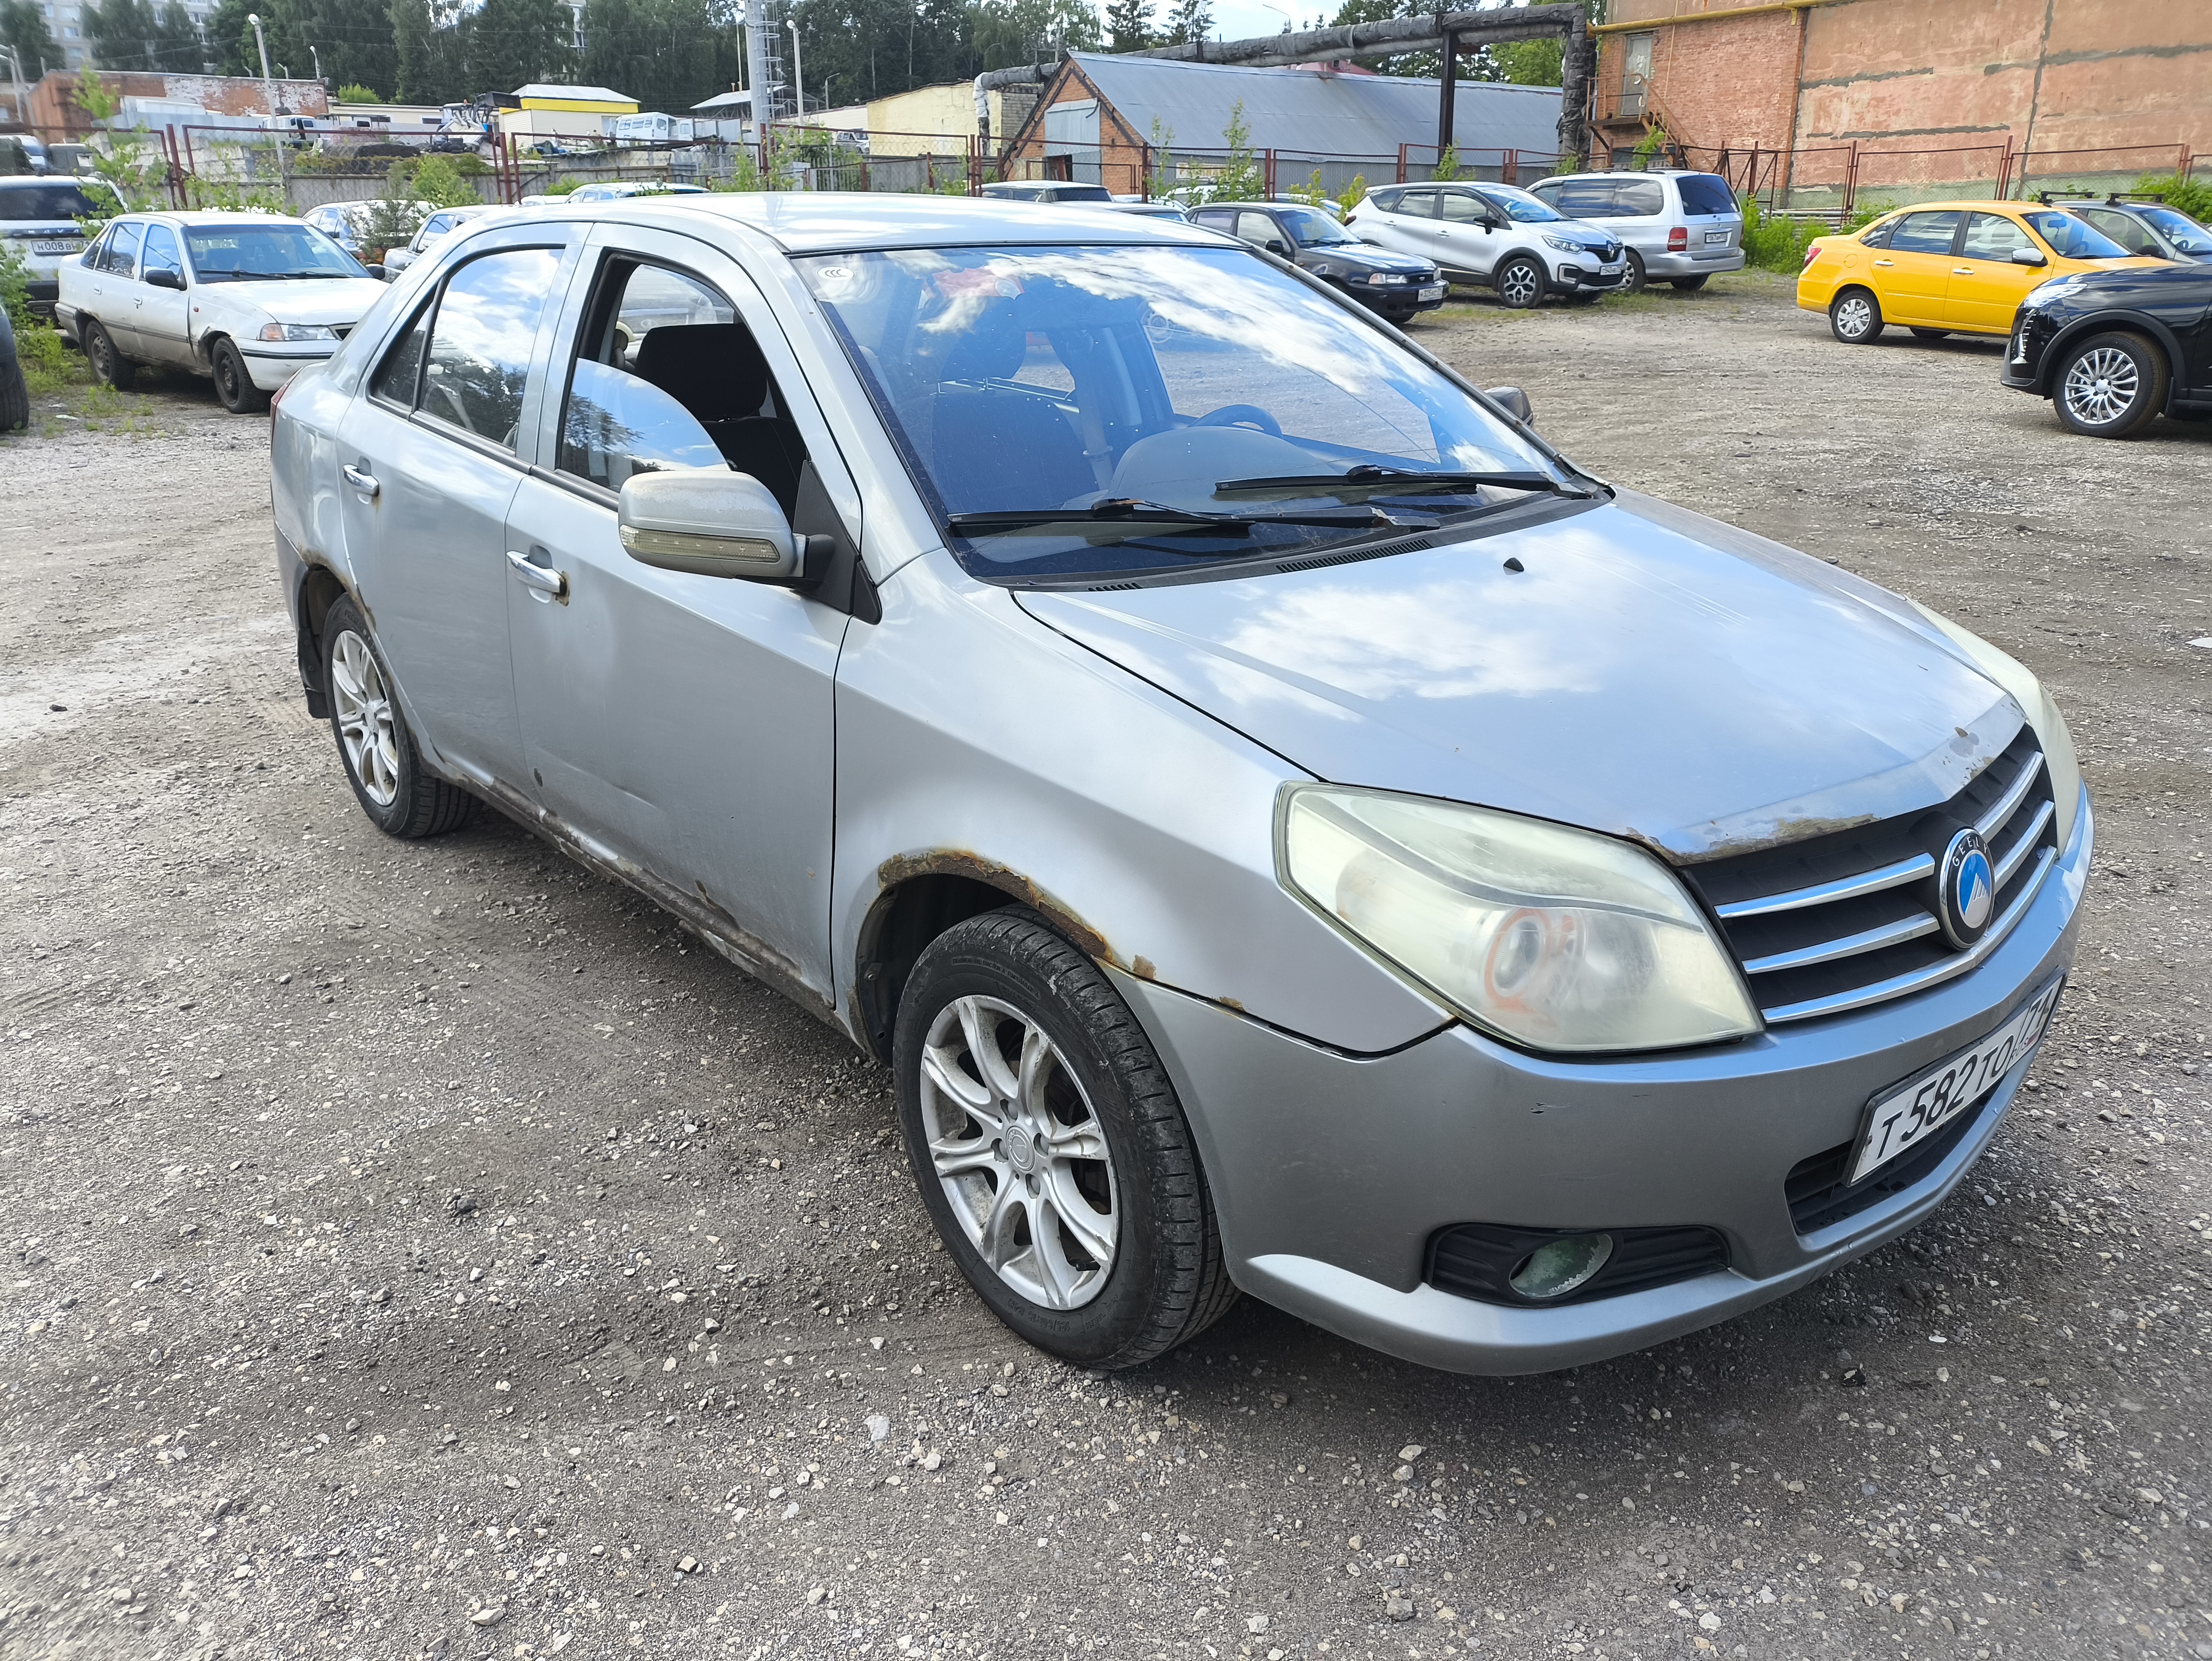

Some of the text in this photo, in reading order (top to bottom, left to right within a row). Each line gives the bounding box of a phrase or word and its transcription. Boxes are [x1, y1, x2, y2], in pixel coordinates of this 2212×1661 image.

[1952, 836, 1988, 867] GEELY
[2019, 987, 2053, 1044] 71
[2011, 1037, 2029, 1061] RUS
